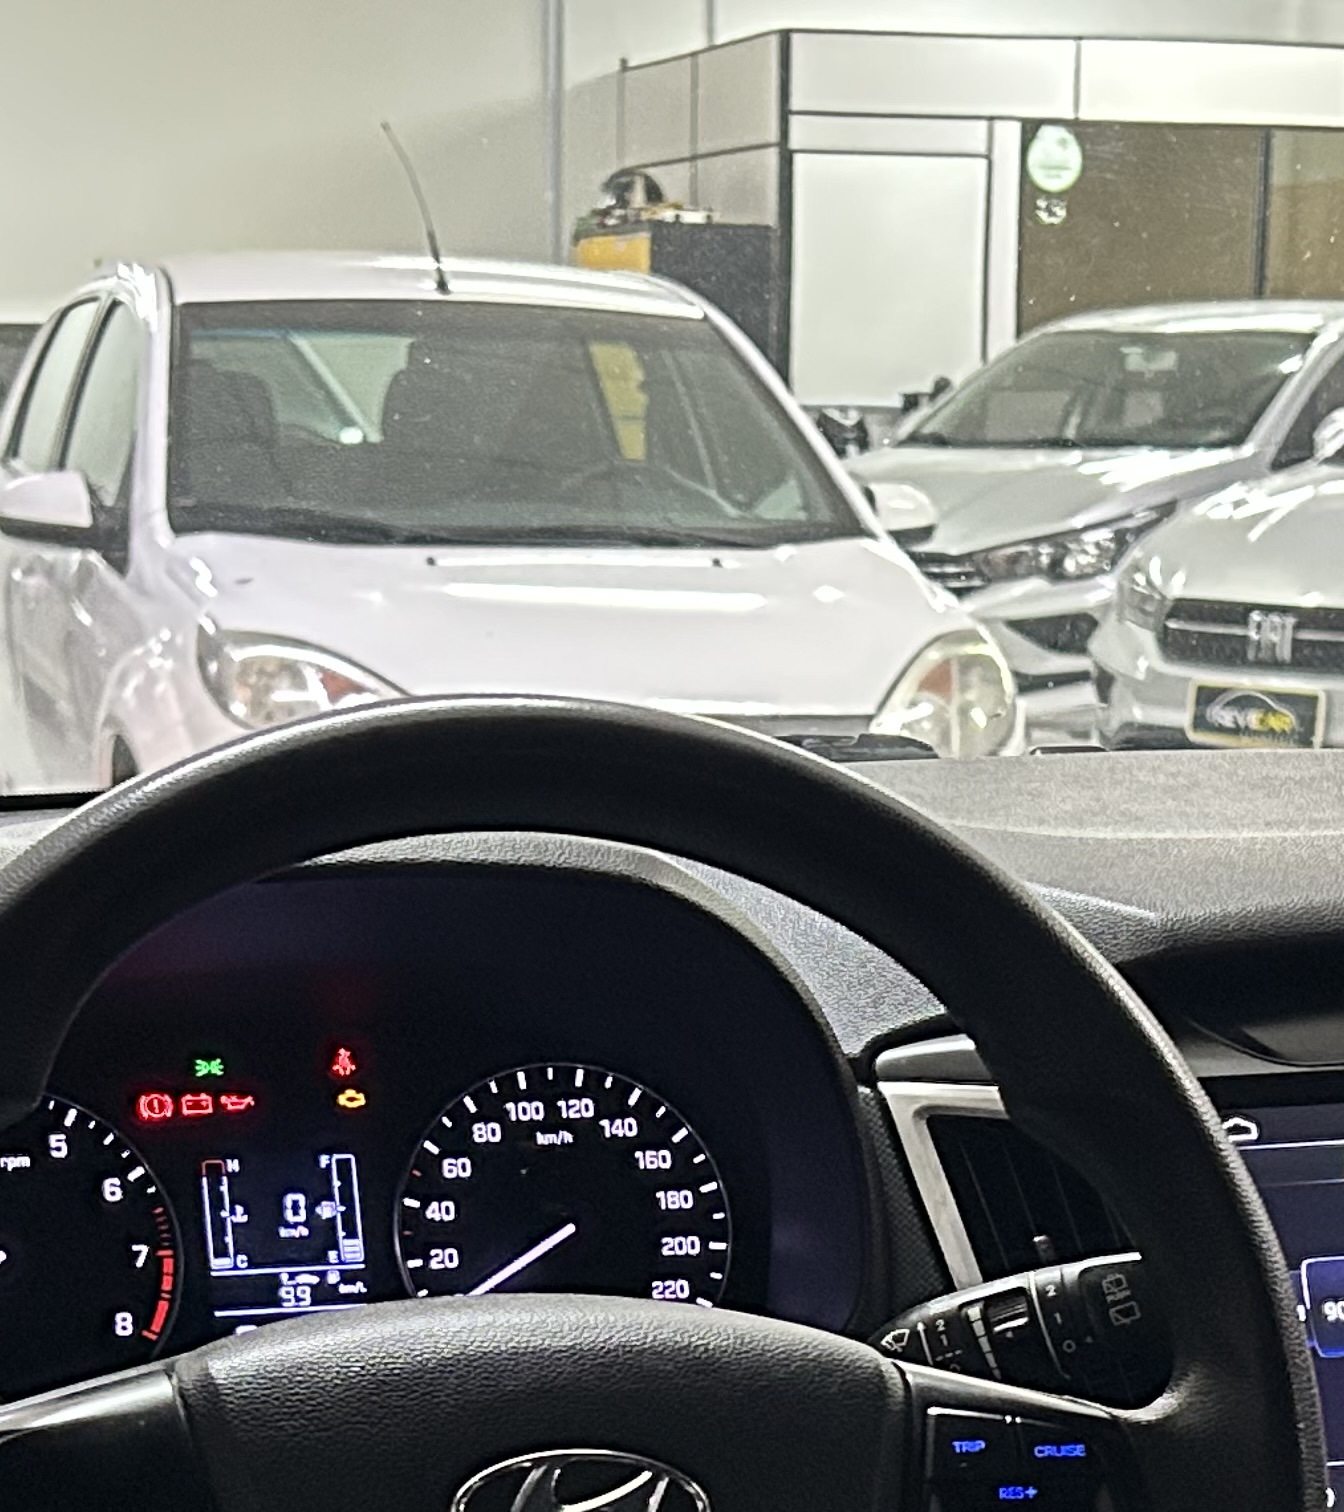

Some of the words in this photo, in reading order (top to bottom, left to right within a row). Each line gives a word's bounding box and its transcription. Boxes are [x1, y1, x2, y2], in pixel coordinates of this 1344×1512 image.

[504, 1101, 544, 1121] 100
[557, 1098, 594, 1118] 120
[472, 1122, 501, 1142] 80
[599, 1117, 637, 1137] 140
[49, 1134, 67, 1158] 5
[536, 1130, 573, 1145] km/h
[319, 1155, 330, 1168] F
[443, 1158, 471, 1178] 60
[635, 1150, 672, 1169] 160
[103, 1178, 123, 1201] 6
[656, 1190, 693, 1209] 180
[283, 1193, 306, 1223] 0
[425, 1201, 455, 1221] 40
[132, 1245, 149, 1267] 7
[662, 1236, 700, 1256] 200
[236, 1255, 248, 1268] C
[328, 1250, 339, 1264] E
[429, 1248, 459, 1269] 20
[279, 1285, 312, 1307] 99
[652, 1279, 689, 1299] 220
[115, 1312, 133, 1336] 8
[952, 1440, 985, 1453] TRIP
[1034, 1444, 1085, 1457] CRUISE
